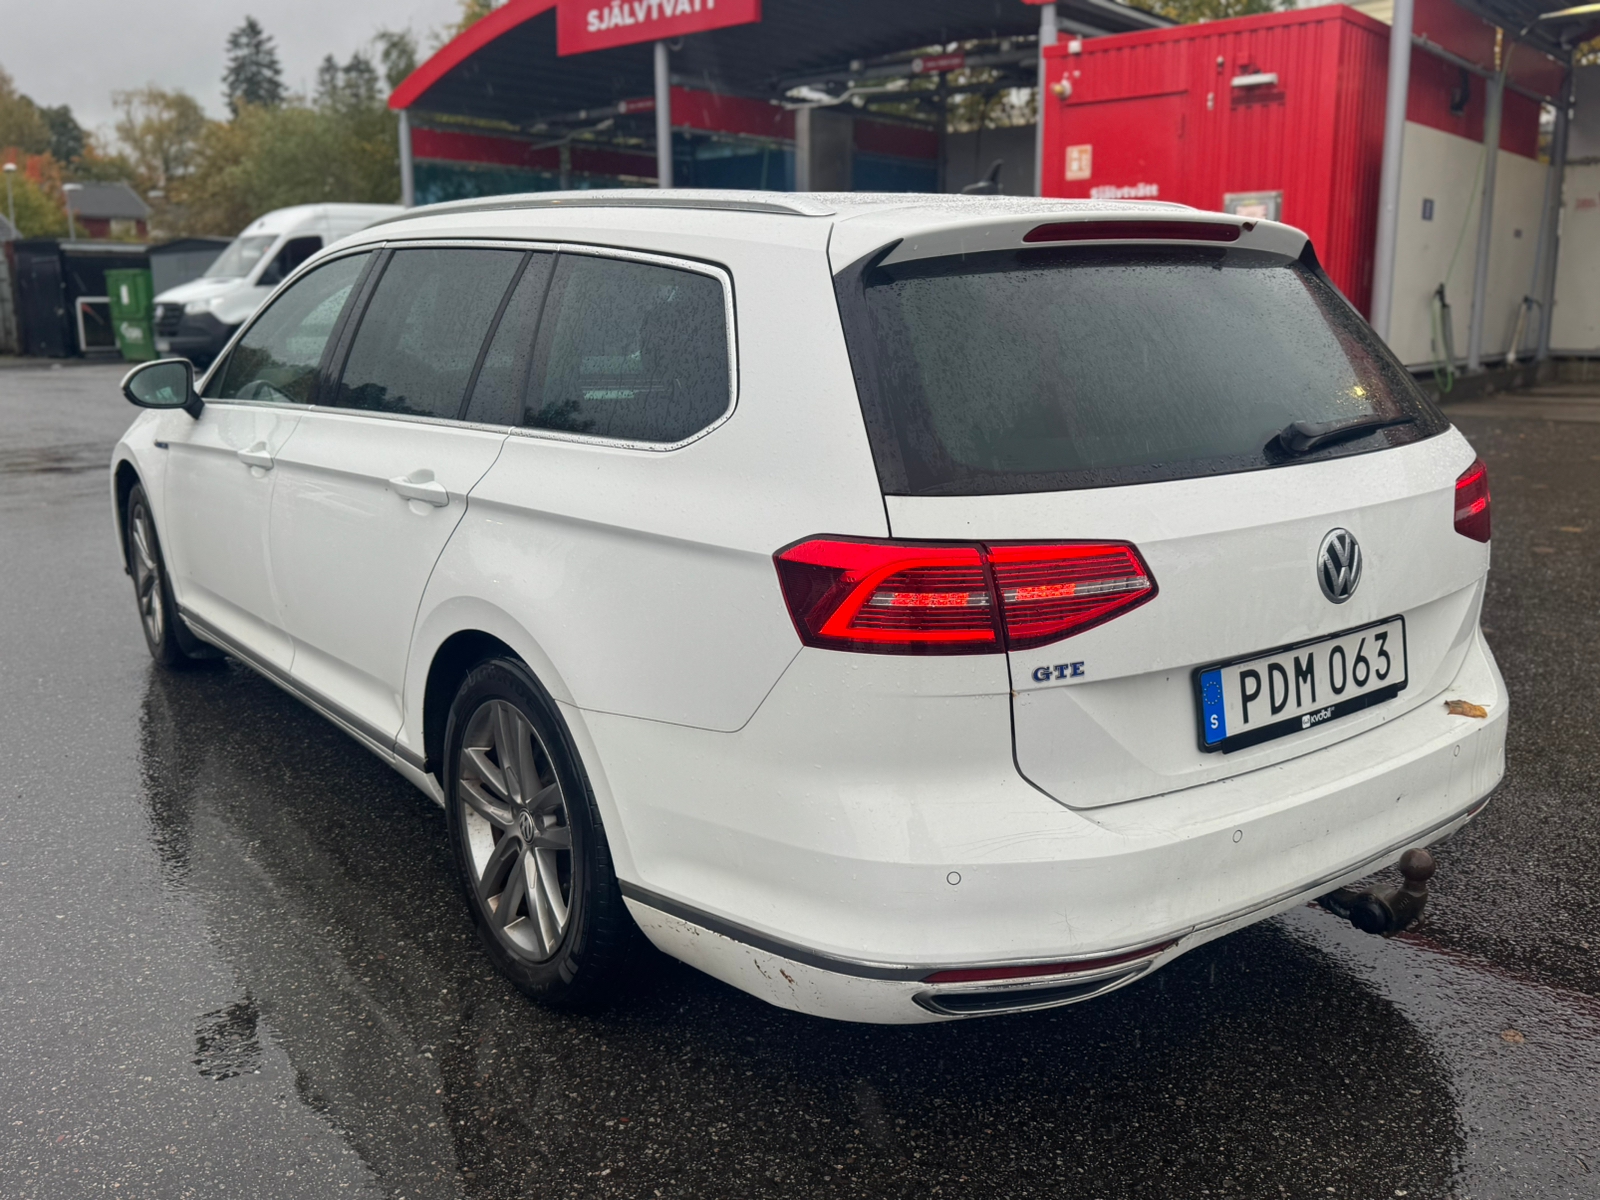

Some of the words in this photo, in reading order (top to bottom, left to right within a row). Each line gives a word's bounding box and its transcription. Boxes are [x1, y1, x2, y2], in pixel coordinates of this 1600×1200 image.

[1032, 661, 1085, 683] GTE
[1239, 652, 1316, 724] PDM
[1329, 630, 1391, 695] 063
[1210, 714, 1219, 729] S
